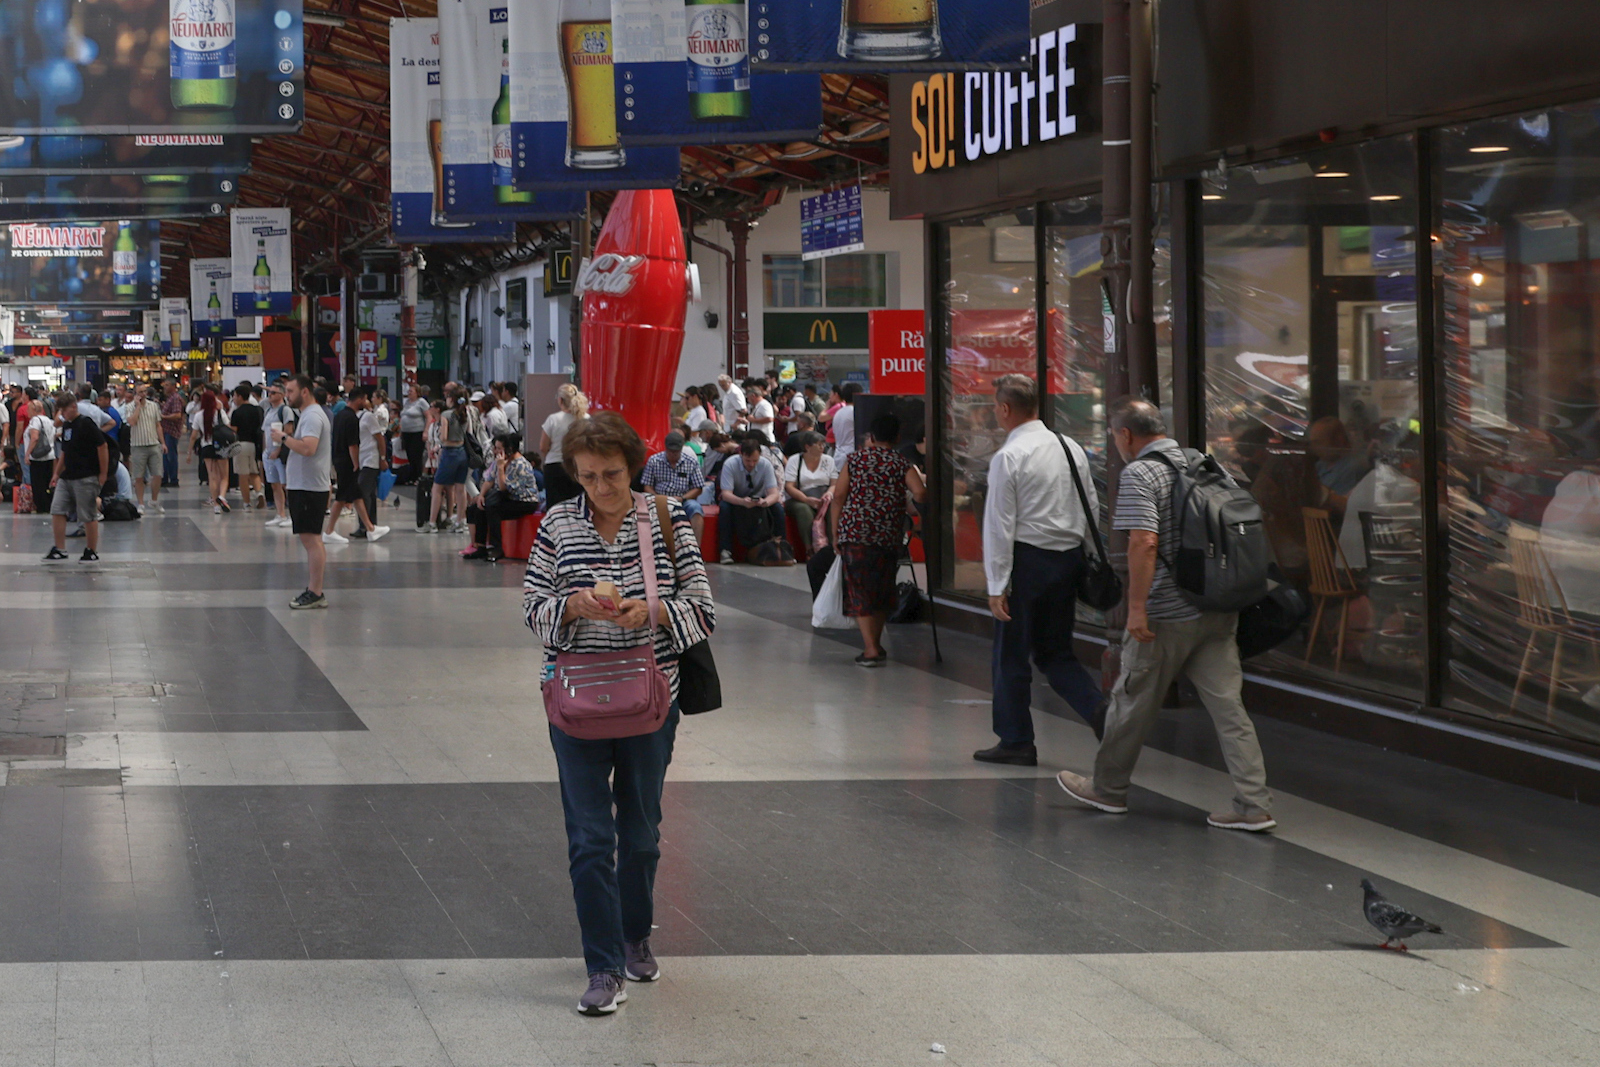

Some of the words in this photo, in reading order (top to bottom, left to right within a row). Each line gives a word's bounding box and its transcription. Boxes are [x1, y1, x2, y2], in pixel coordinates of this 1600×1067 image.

[172, 12, 234, 37] NEUMARKT
[687, 30, 746, 54] NEUMARKT
[402, 57, 416, 66] La
[571, 48, 613, 66] NEUMARK
[911, 72, 956, 174] SO!
[964, 22, 1077, 161] COFFEE
[8, 223, 106, 248] NEUMARKT
[11, 249, 22, 257] PE
[23, 249, 54, 257] GUSTUL
[54, 248, 104, 258] BĂRBAȚILOR
[900, 330, 925, 349] Ră
[29, 345, 63, 357] KFC
[167, 348, 209, 361] SUBWAY
